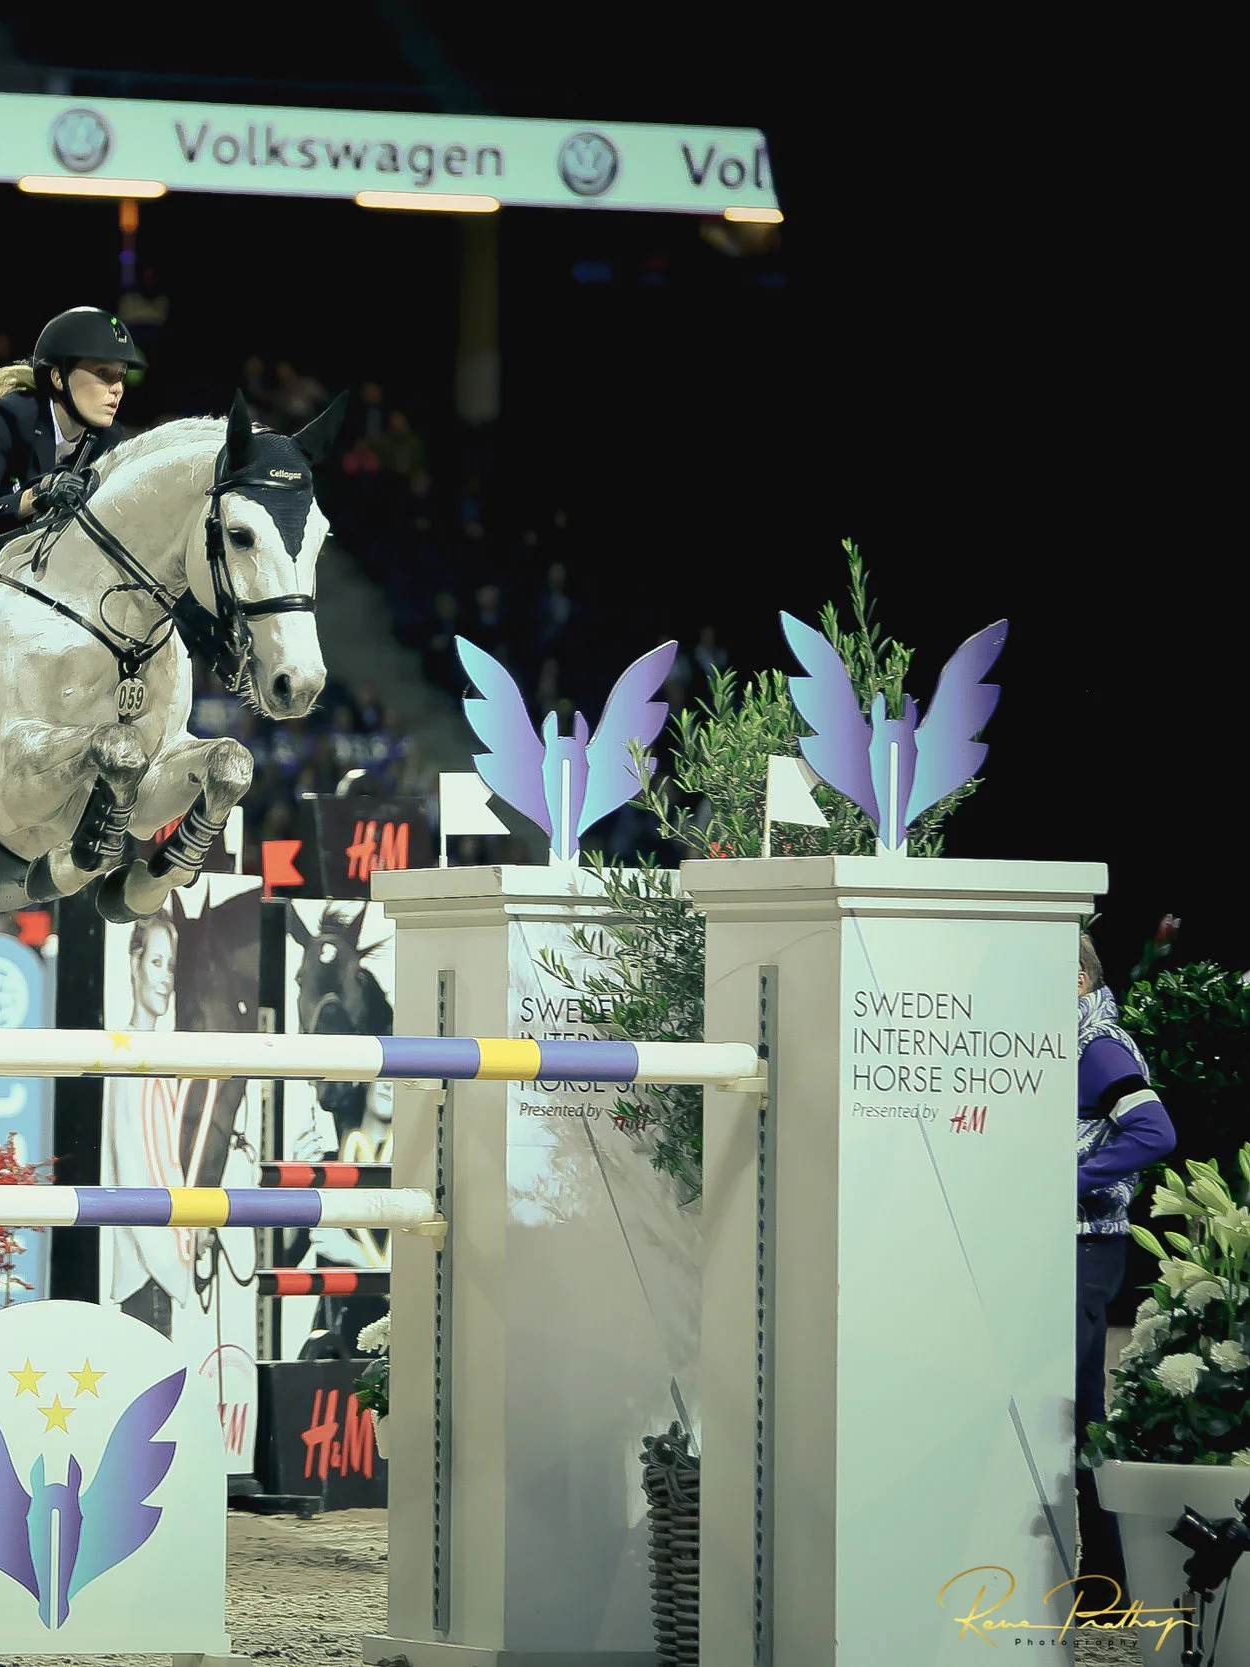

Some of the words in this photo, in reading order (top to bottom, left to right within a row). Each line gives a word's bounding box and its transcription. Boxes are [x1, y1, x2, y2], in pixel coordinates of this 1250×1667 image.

[174, 121, 504, 187] Volkswagen
[680, 143, 767, 190] Vol
[119, 685, 144, 710] 059
[520, 997, 626, 1024] SWEDE
[853, 990, 973, 1020] SWEDEN
[853, 1027, 1067, 1060] INTERNATIONAL
[853, 1064, 943, 1093] HORSE
[952, 1066, 1044, 1095] SHOW
[519, 1102, 584, 1117] Presented
[586, 1102, 602, 1120] by
[852, 1102, 919, 1118] Presented
[922, 1104, 939, 1122] by
[949, 1105, 989, 1135] H&M
[301, 1388, 375, 1482] H&M
